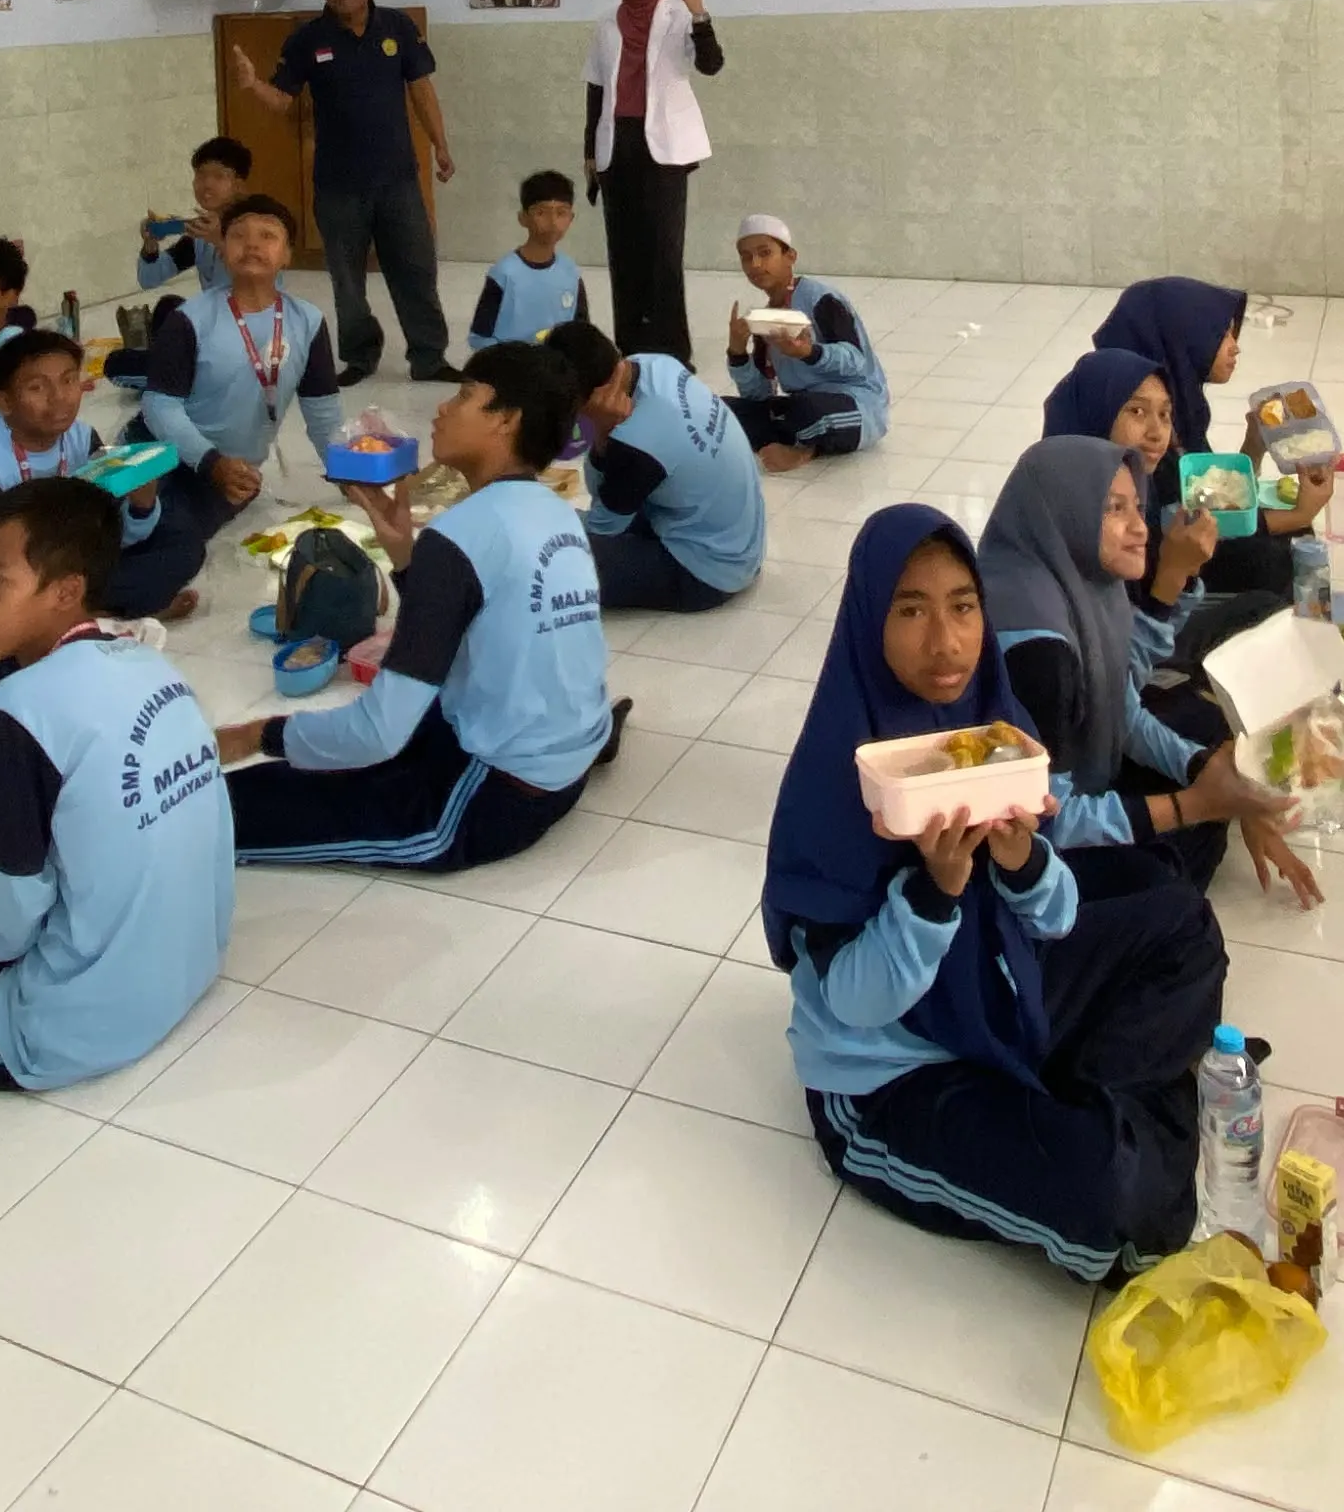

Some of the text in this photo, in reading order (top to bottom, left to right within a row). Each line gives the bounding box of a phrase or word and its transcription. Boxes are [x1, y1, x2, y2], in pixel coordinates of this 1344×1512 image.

[530, 569, 545, 613] SMP
[121, 753, 142, 809] SMP
[153, 742, 218, 795] MALA
